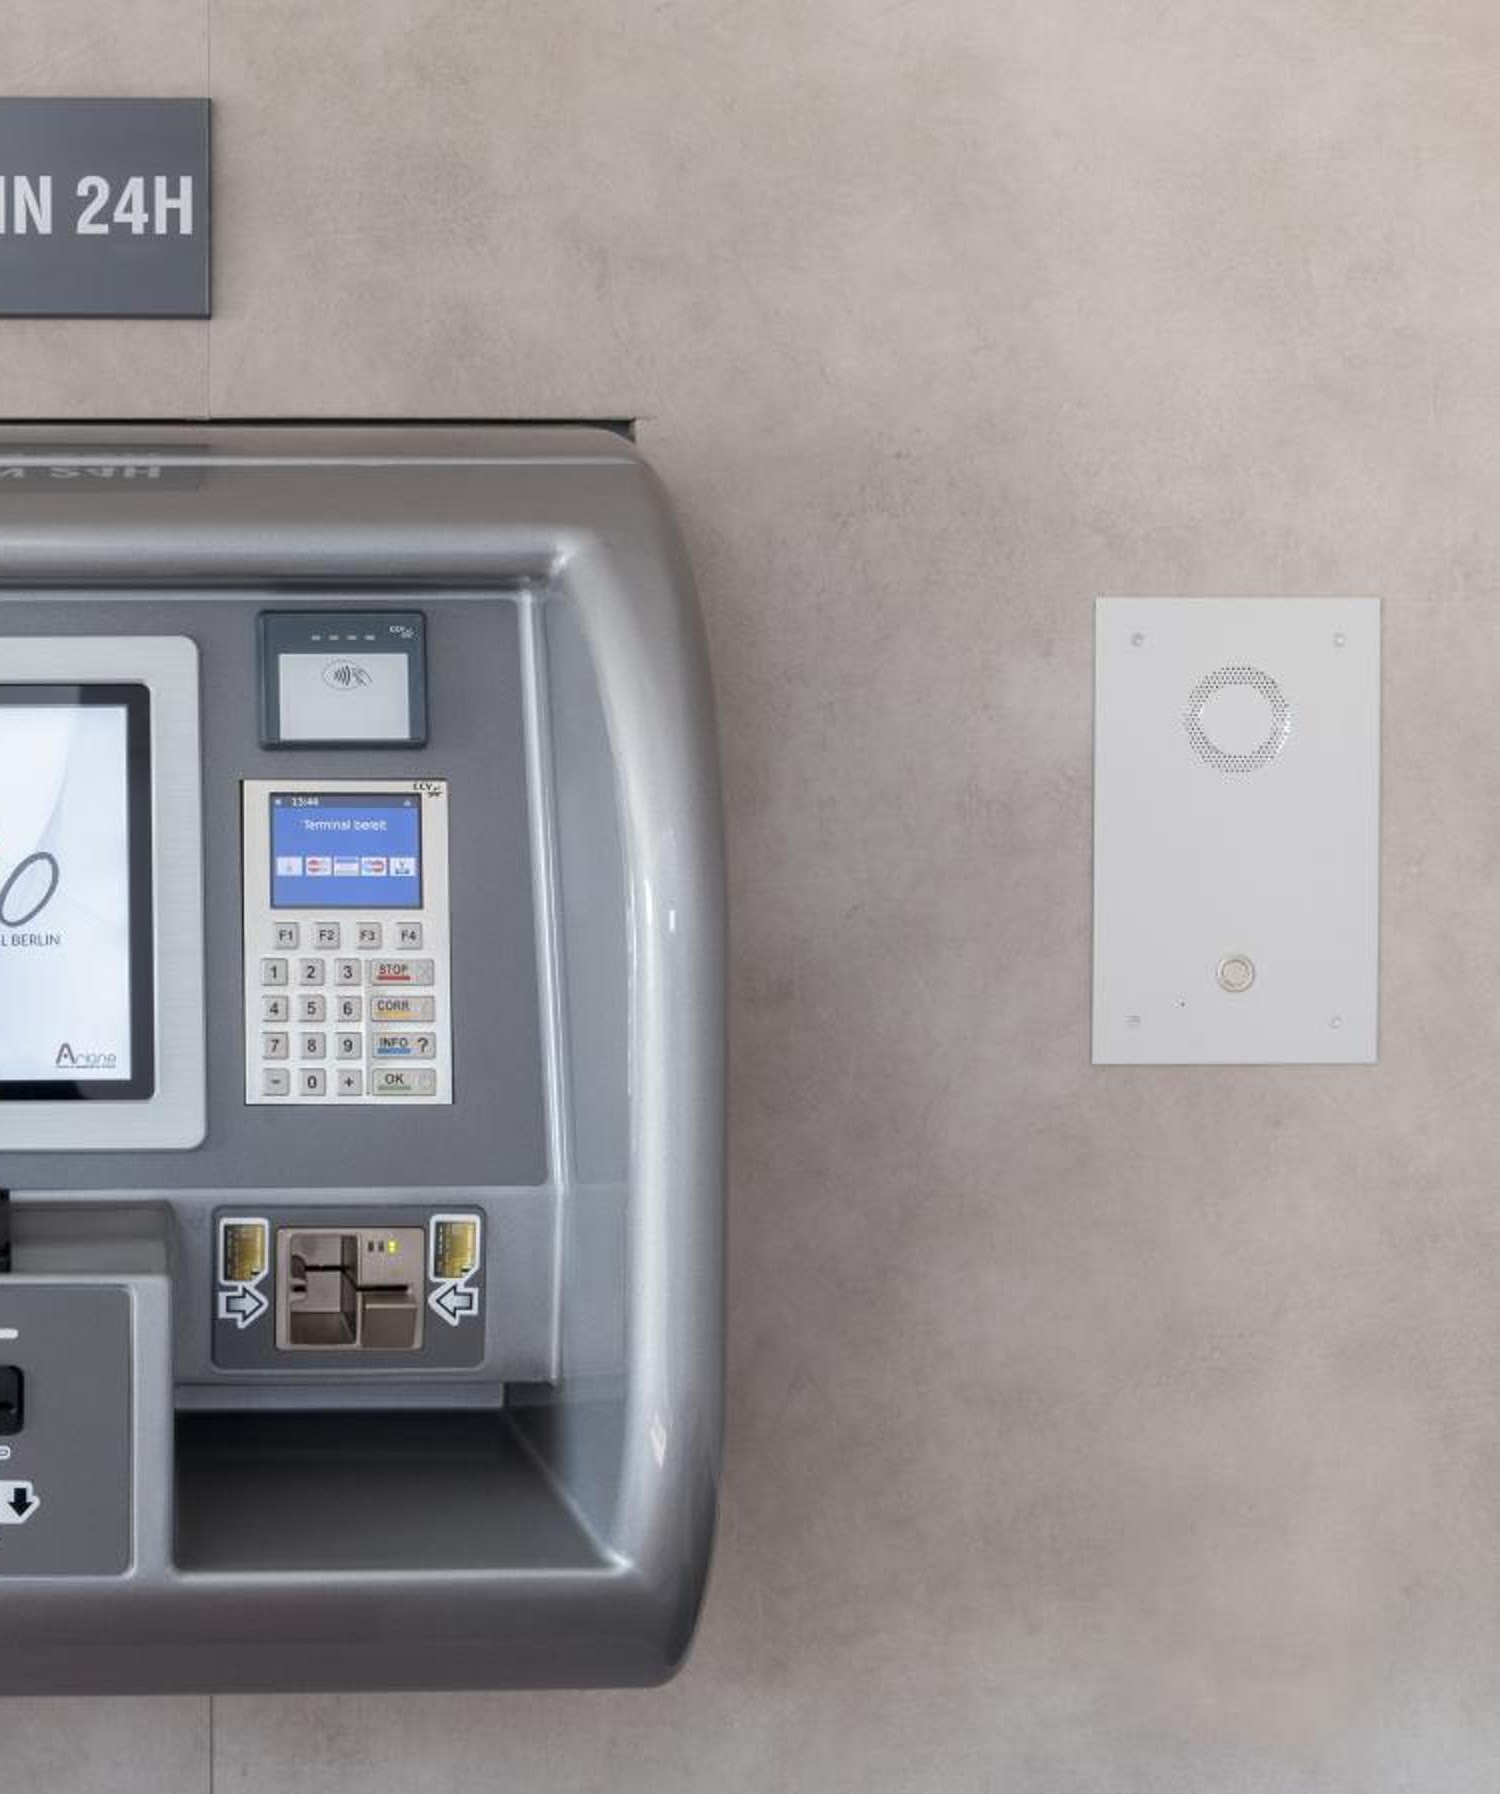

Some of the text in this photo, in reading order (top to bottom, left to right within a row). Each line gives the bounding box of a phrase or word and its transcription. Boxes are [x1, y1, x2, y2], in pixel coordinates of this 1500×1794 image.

[75, 174, 194, 236] 24H
[303, 819, 351, 831] Terminal
[11, 933, 61, 947] BERLIN
[279, 929, 416, 941] F1 F2 F3 F4
[269, 964, 409, 979] 1 2 3 STOP
[269, 1002, 279, 1015] 4
[307, 1002, 316, 1015] 5
[343, 1002, 353, 1015] 6
[270, 1039, 280, 1052] 7
[307, 1039, 317, 1052] 8
[343, 1039, 353, 1052] 9
[379, 1037, 409, 1048] INFO
[307, 1075, 317, 1089] 0
[384, 1073, 405, 1085] OK
